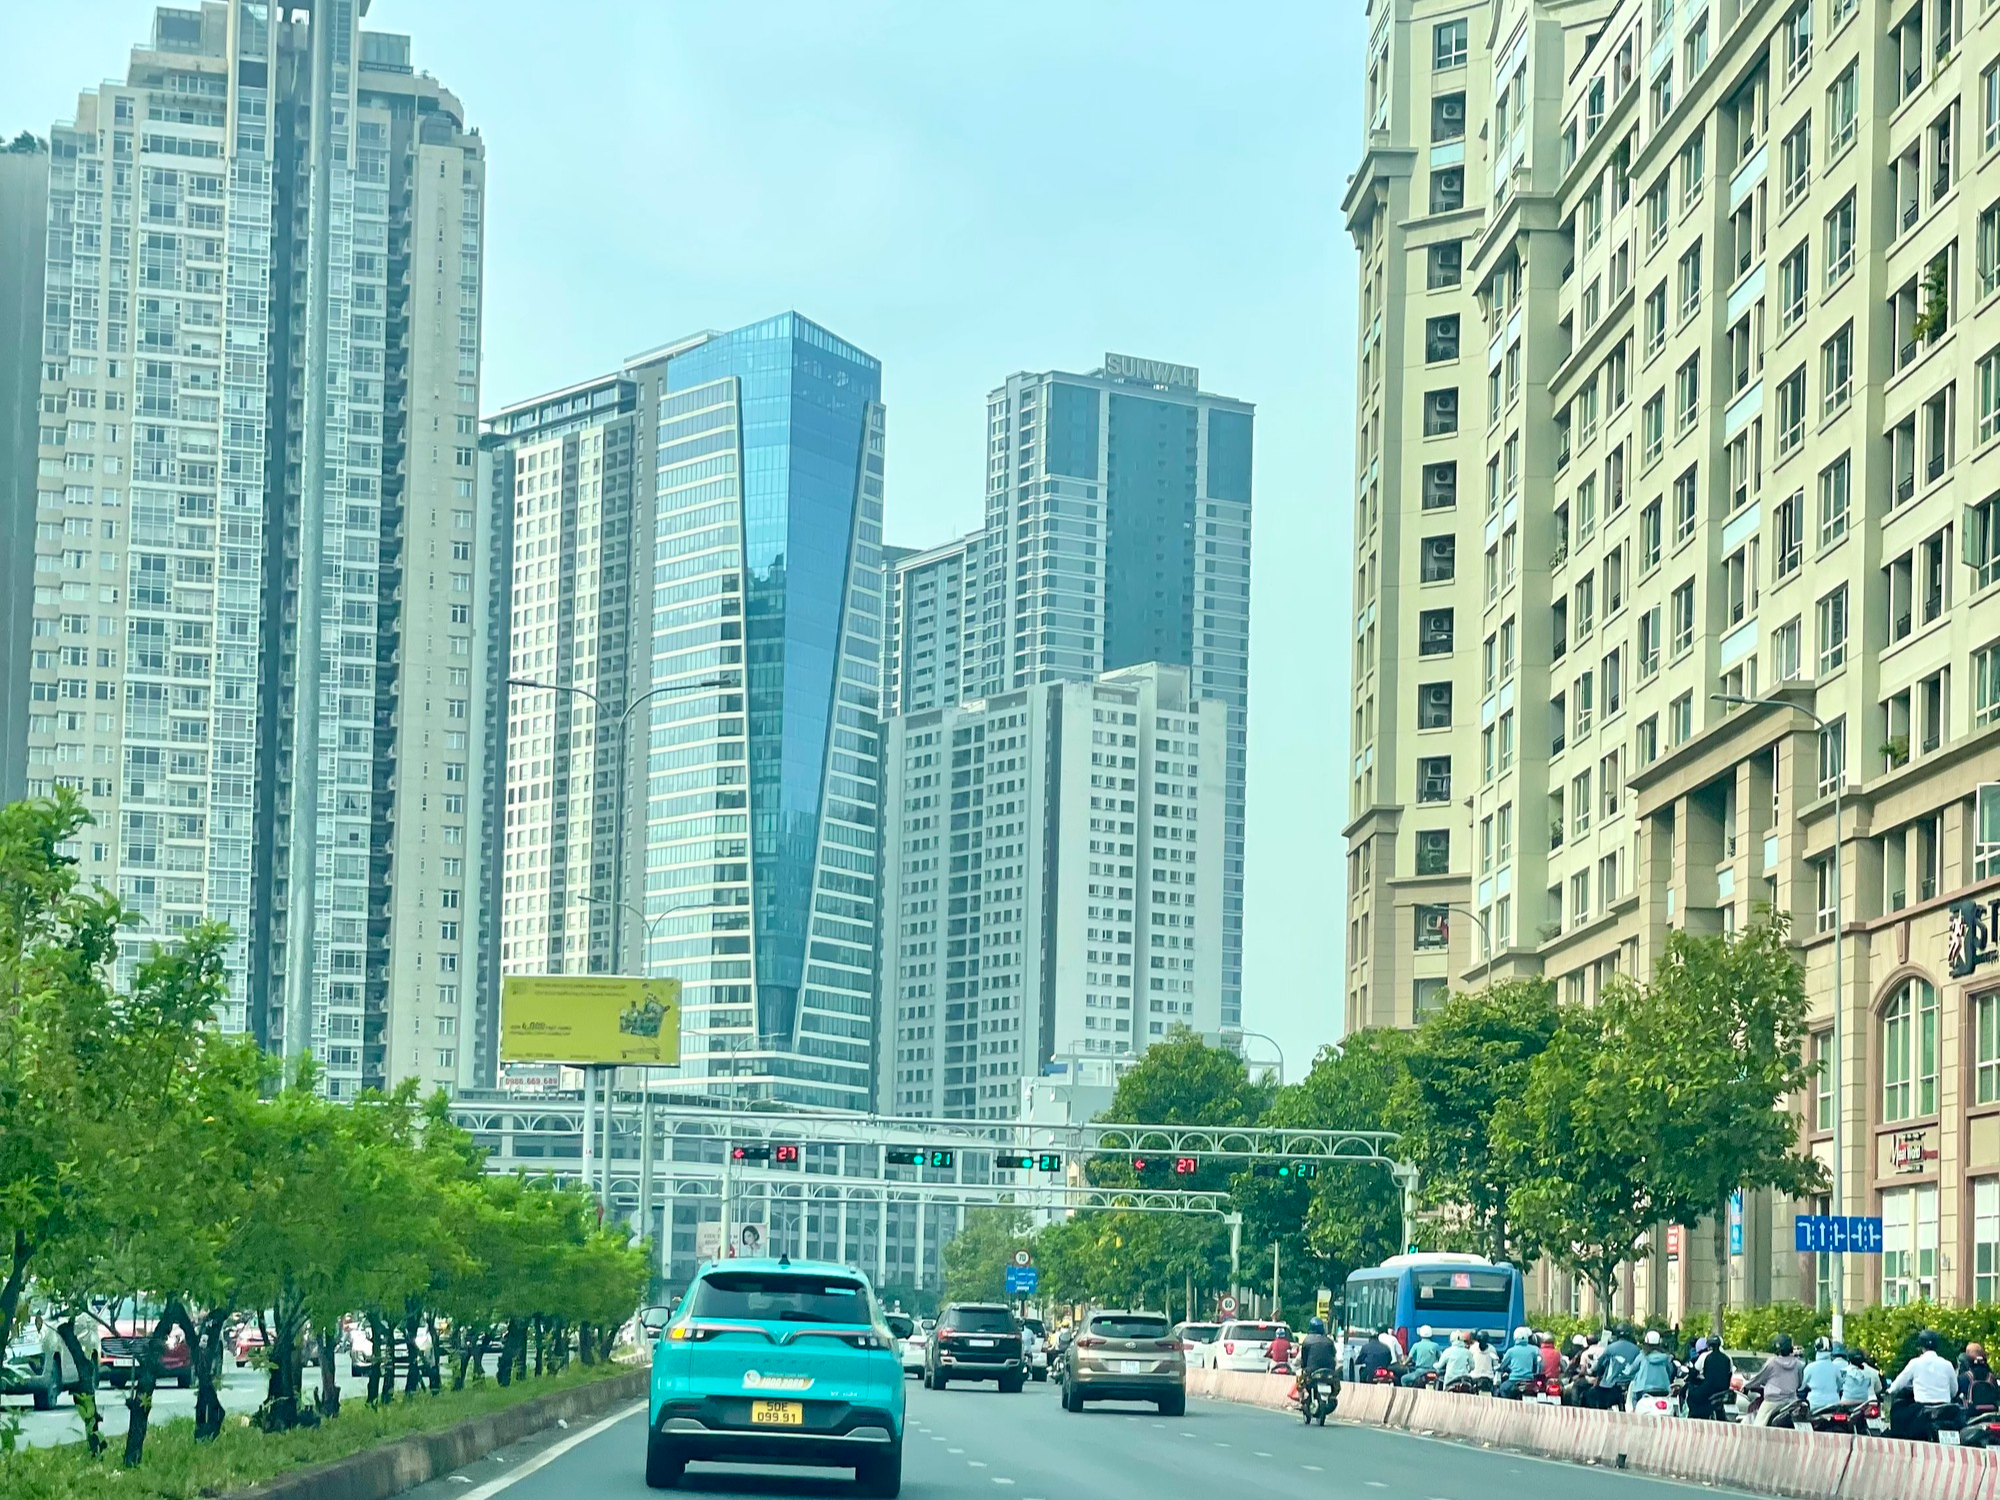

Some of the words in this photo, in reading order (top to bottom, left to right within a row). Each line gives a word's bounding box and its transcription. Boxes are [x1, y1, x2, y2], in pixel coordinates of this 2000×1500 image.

[1107, 355, 1197, 388] SUNWAH
[779, 1147, 796, 1160] 27
[934, 1152, 950, 1165] 21
[1041, 1156, 1058, 1169] 21
[1176, 1159, 1195, 1173] 27
[1297, 1164, 1314, 1178] 21
[1018, 1253, 1027, 1262] 70
[1224, 1299, 1233, 1309] 60
[766, 1402, 788, 1411] 50E
[757, 1412, 796, 1423] 099.91
